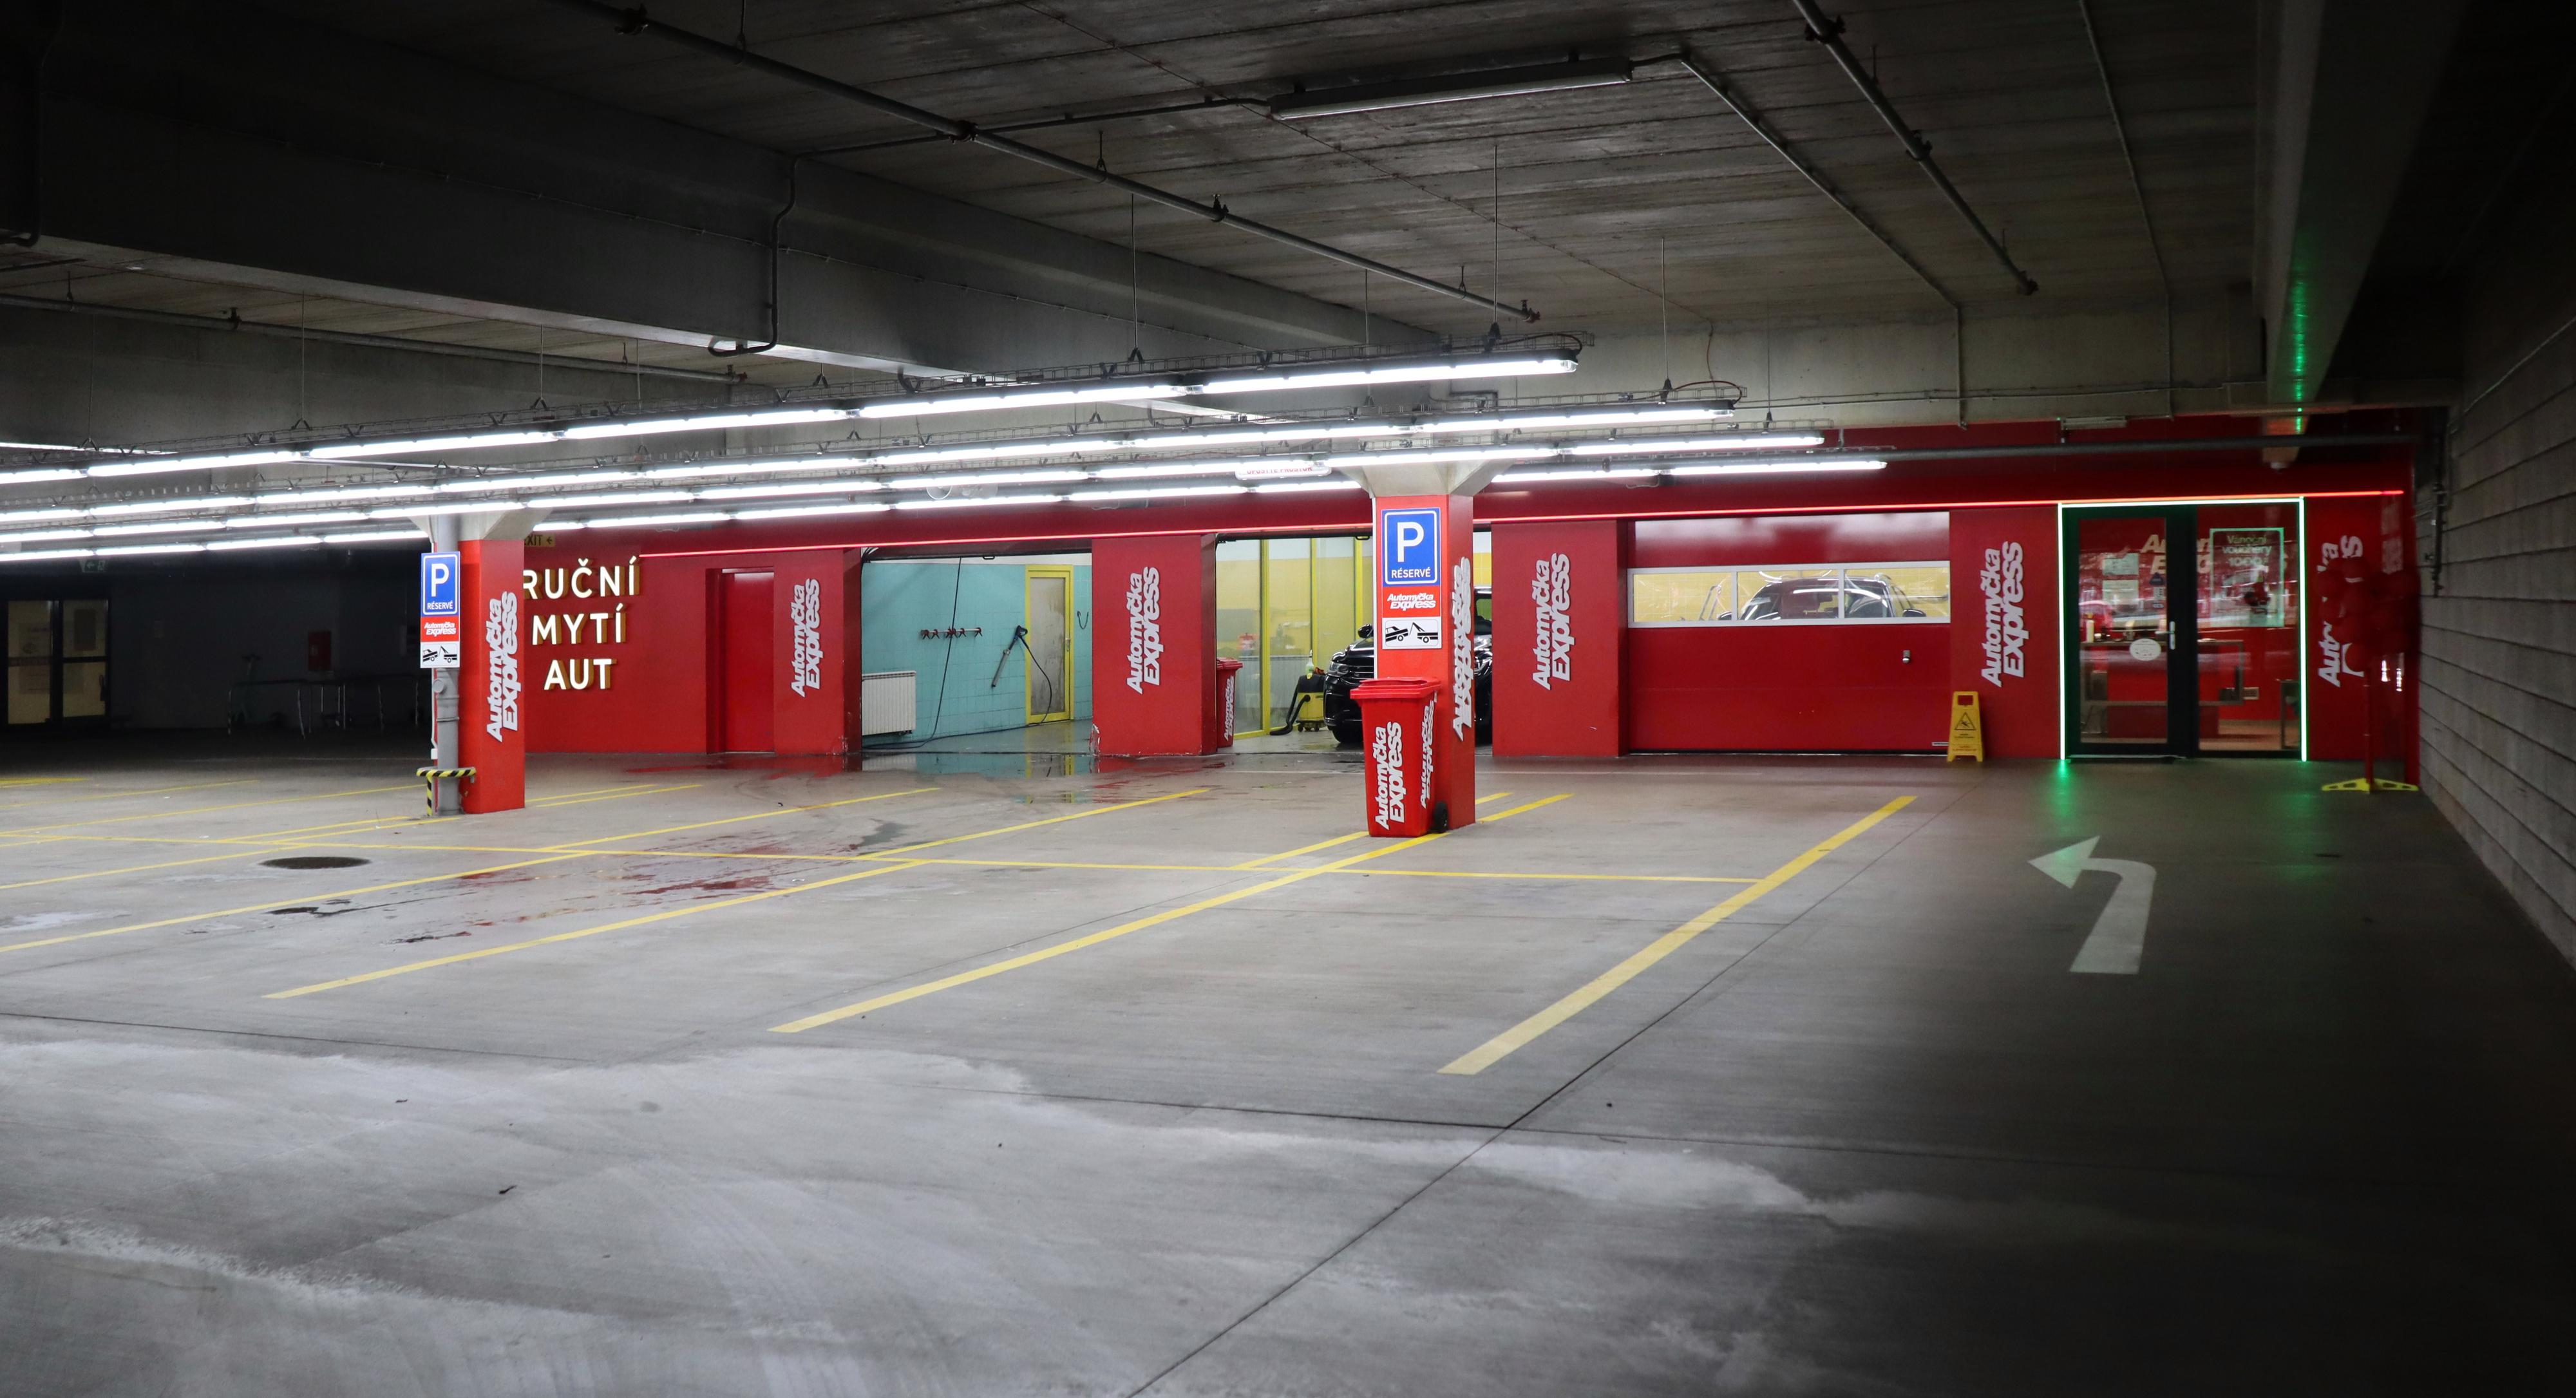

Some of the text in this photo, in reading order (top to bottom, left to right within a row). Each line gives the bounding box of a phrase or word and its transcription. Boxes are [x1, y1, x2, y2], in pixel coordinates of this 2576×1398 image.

[431, 563, 450, 597] P
[523, 556, 637, 600] RUČNÍ
[524, 534, 543, 546] XIT
[1391, 567, 1431, 578] RÉSERVÉ
[1397, 521, 1424, 562] P
[426, 628, 457, 637] Express
[427, 600, 453, 610] RÉSERVÉ
[533, 603, 623, 645] MYTÍ
[791, 585, 806, 698] Automyčka
[806, 578, 824, 690] Express
[1126, 572, 1143, 695] Automyčka
[1143, 566, 1164, 686] Express
[1387, 592, 1434, 601] Automyčka
[1390, 600, 1436, 611] Express
[1532, 560, 1551, 690] Automyčka
[1551, 553, 1575, 681] Express
[1980, 548, 2002, 688] Automyčka
[2002, 541, 2029, 678] Express
[486, 598, 502, 742] Automyčka
[502, 591, 521, 731] Express
[544, 658, 612, 690] AUT
[1372, 726, 1390, 831] Automyčka
[1387, 721, 1406, 823] Express
